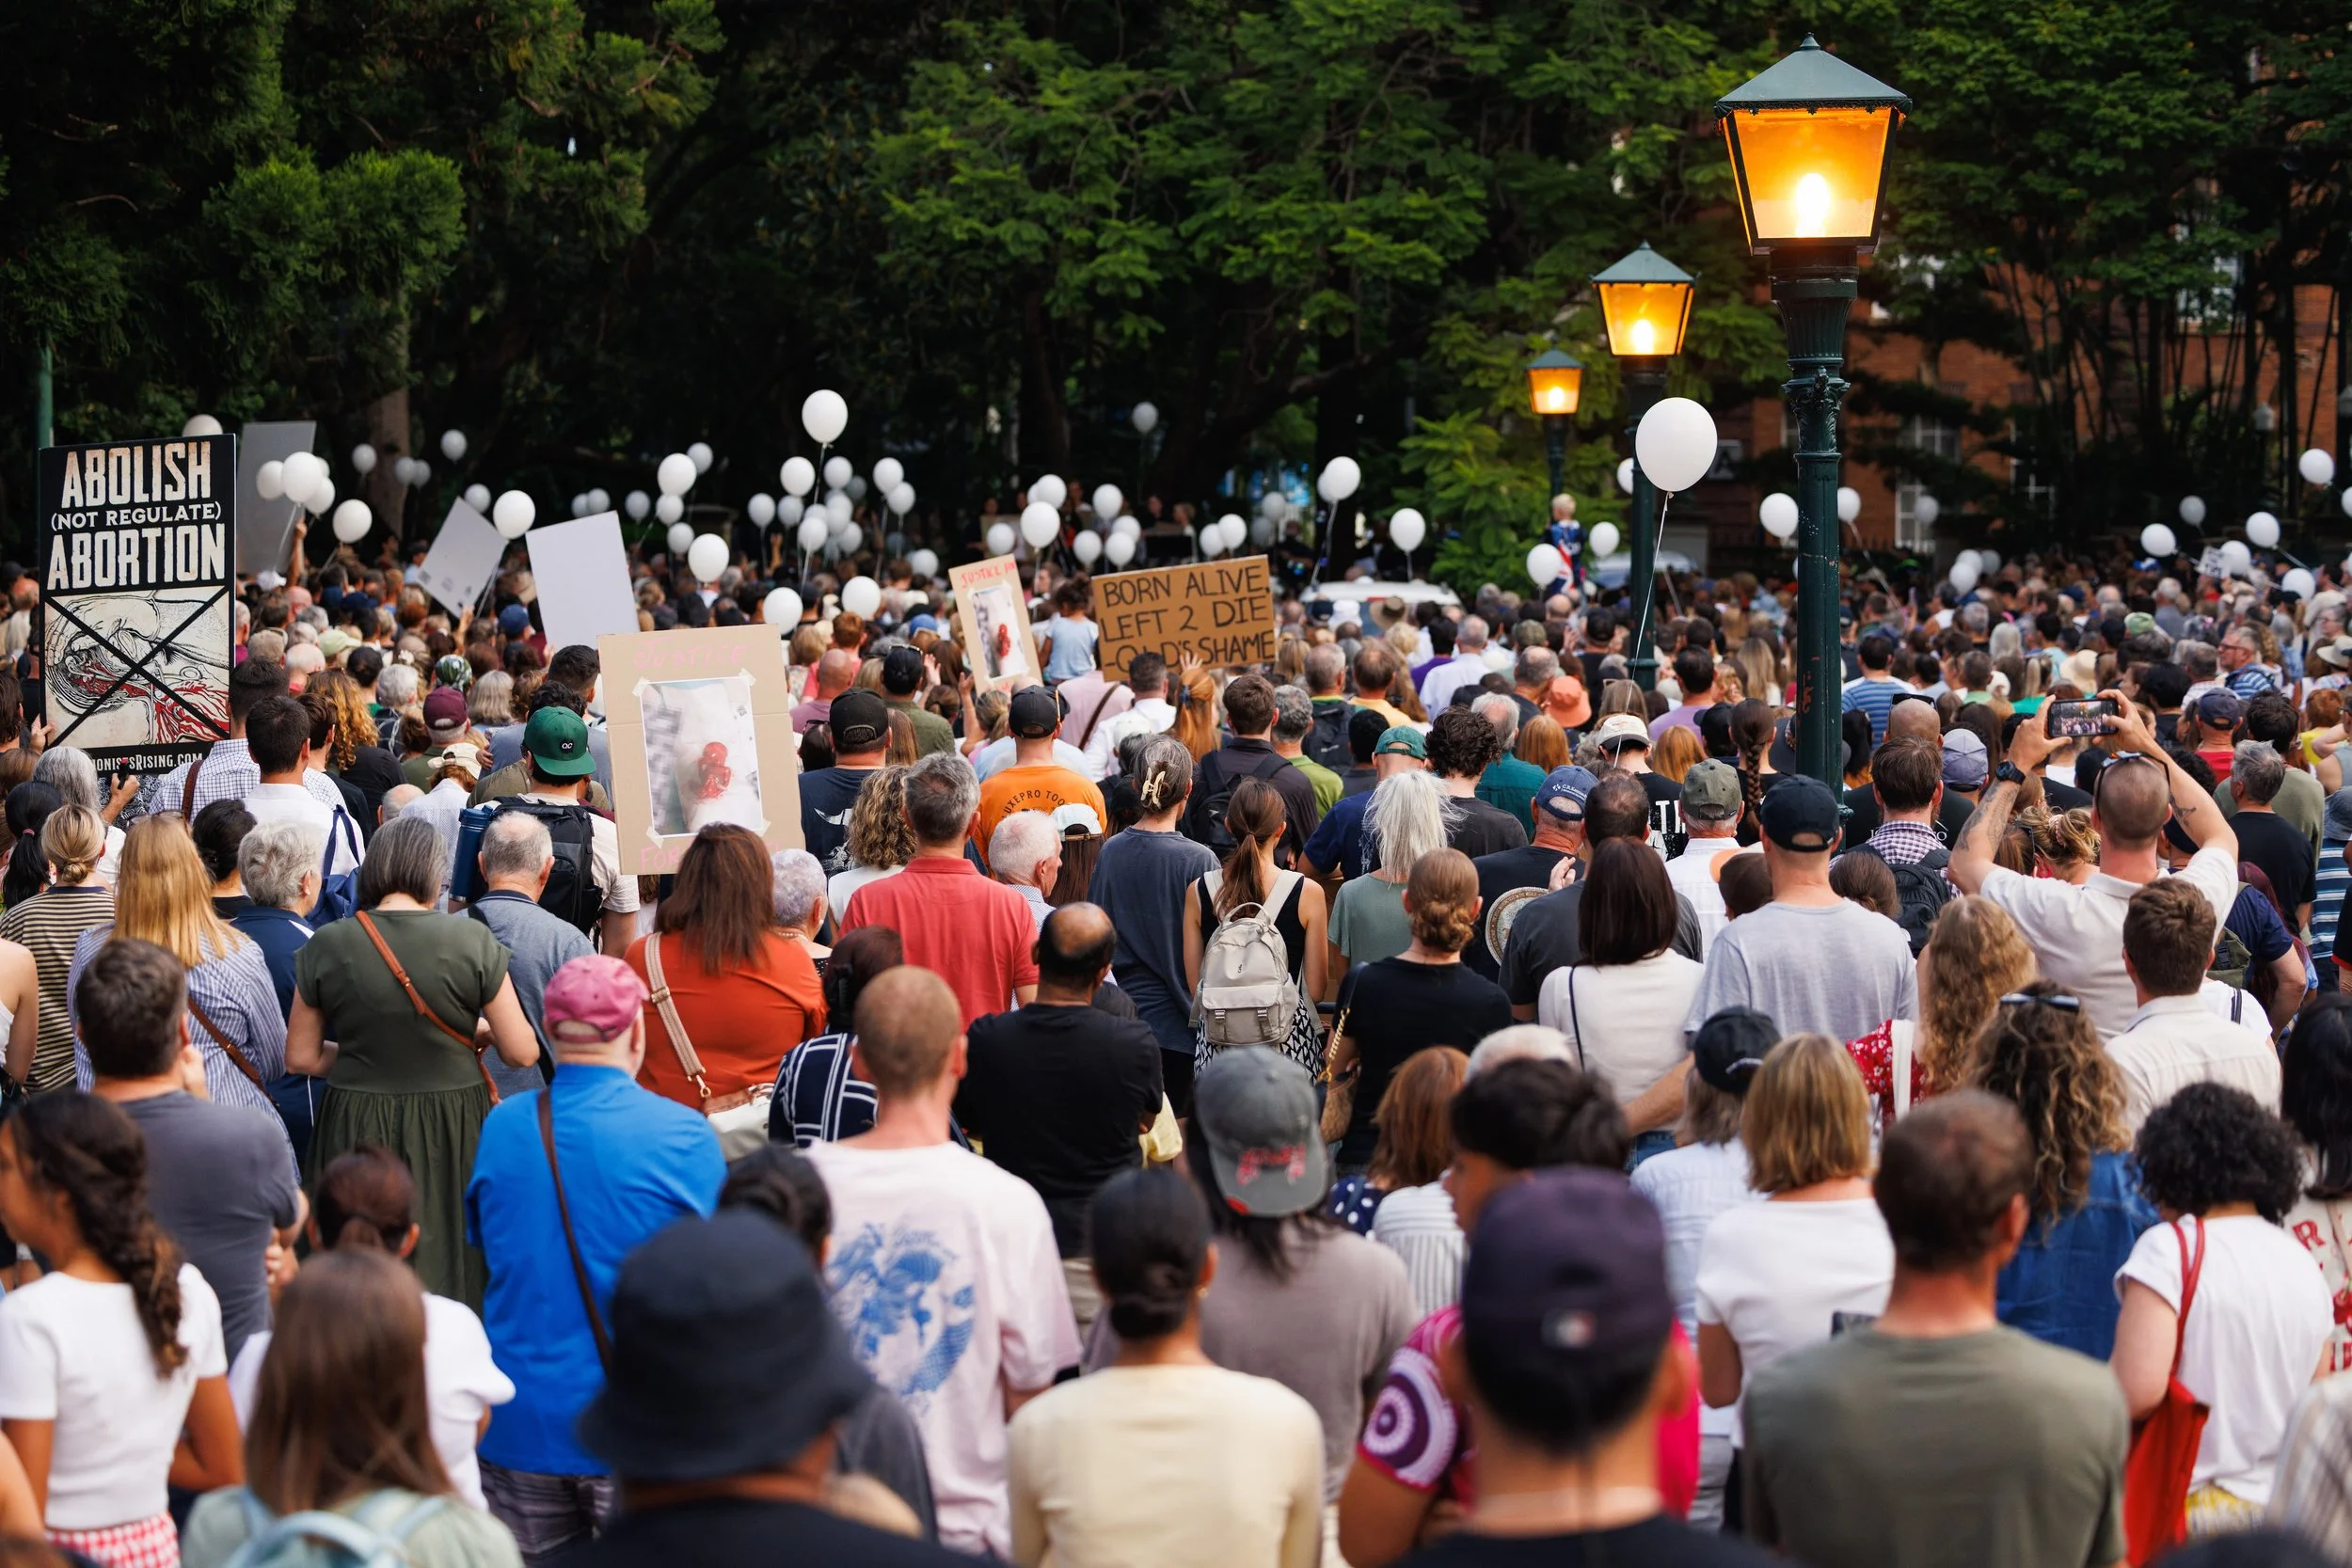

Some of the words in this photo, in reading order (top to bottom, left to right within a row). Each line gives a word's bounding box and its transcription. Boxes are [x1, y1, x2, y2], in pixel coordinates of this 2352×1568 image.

[61, 441, 211, 509] ABOLISH
[51, 512, 98, 531] (NOT
[105, 501, 222, 526] REGULATE)
[47, 523, 225, 591] ABORTION
[1103, 574, 1171, 609] BORN
[1185, 565, 1270, 599] ALIVE,
[1100, 609, 1168, 643] LEFT
[1179, 605, 1199, 631] 2
[1212, 595, 1268, 628] DIE
[632, 635, 749, 670] JUSTICE
[1104, 640, 1194, 673] -QD'S
[1198, 629, 1275, 665] SHAME
[1002, 789, 1041, 818] UXEPRO
[1045, 790, 1069, 806] TOO
[641, 846, 682, 874] FOR
